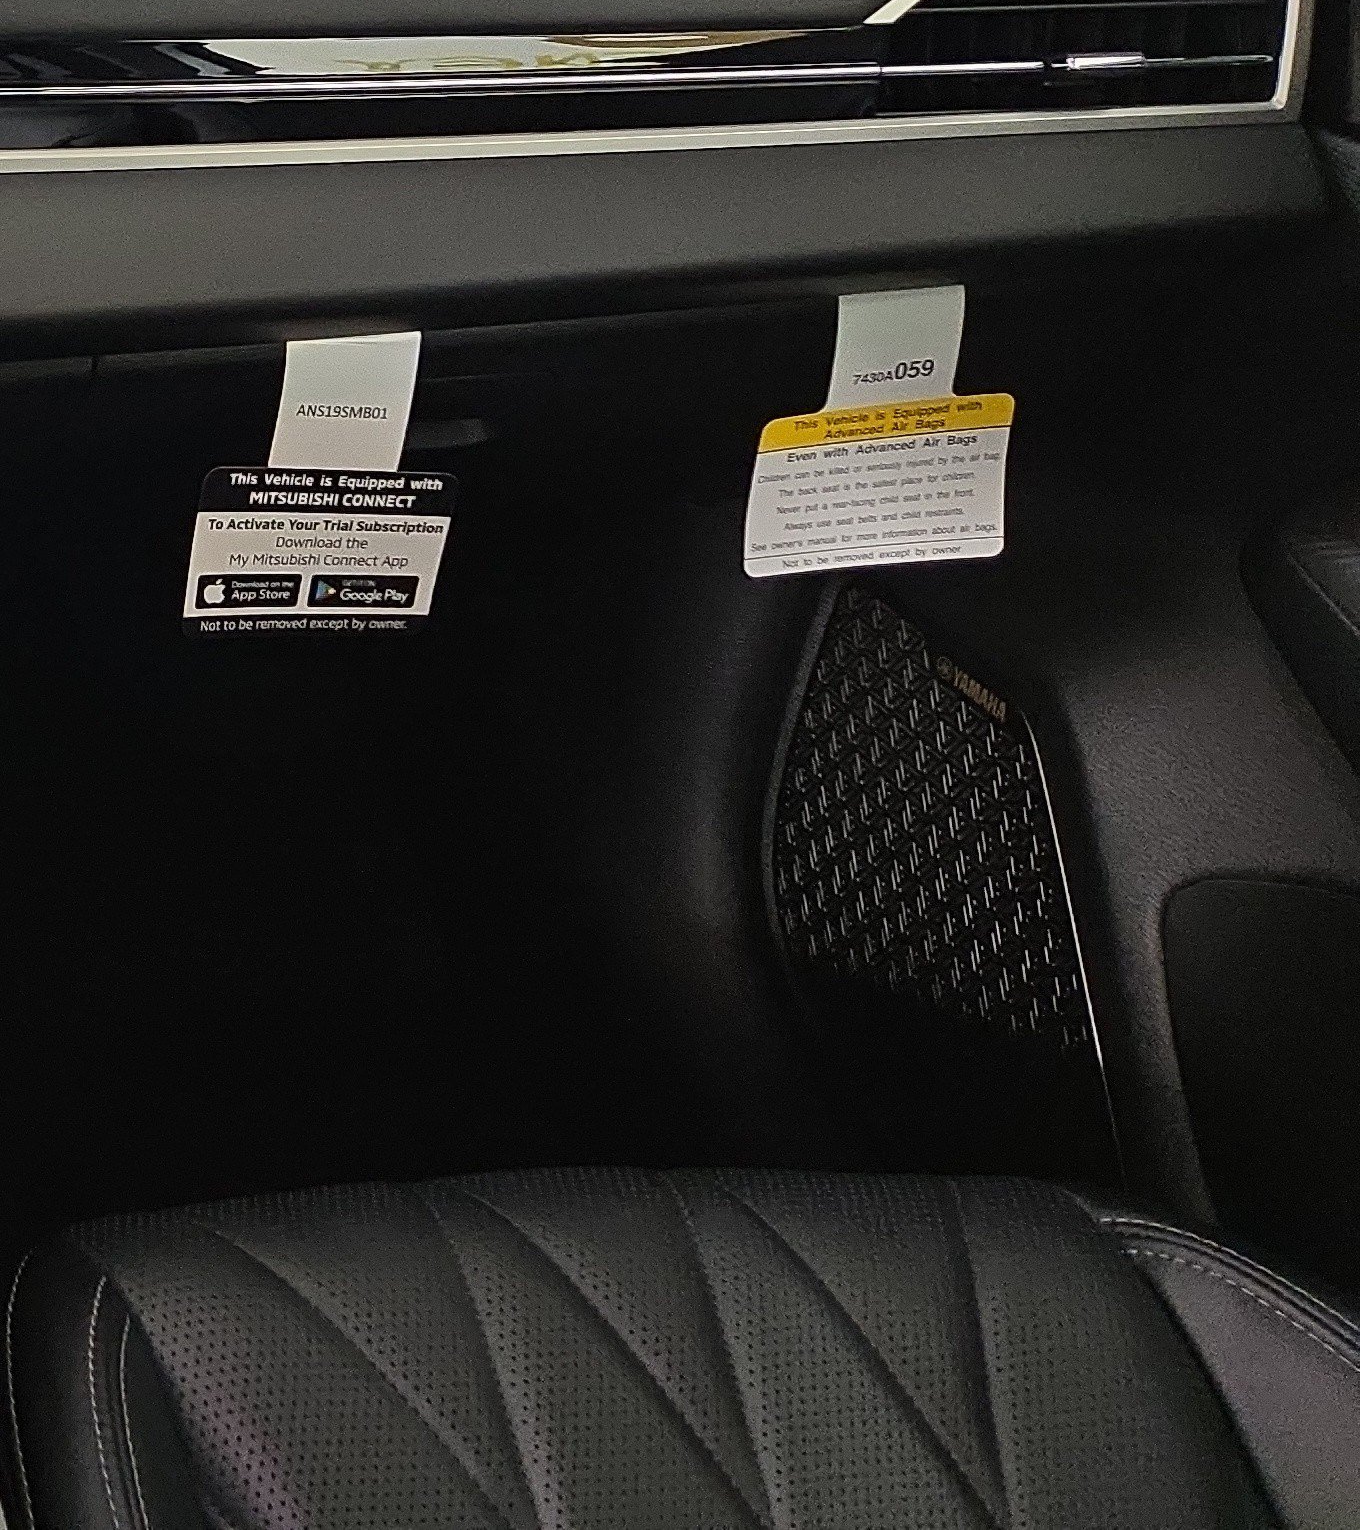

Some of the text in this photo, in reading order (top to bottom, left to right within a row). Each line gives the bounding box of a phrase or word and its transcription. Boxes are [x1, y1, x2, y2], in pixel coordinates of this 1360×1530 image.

[296, 403, 388, 420] ANS19SMB01
[793, 400, 983, 432] This Vehicle is Equipped with
[824, 418, 947, 440] Advanced Air Bags
[787, 433, 978, 463] Even with Advanced Air Bags
[230, 473, 443, 491] This Vehicle is Equipped with
[249, 491, 417, 508] MITSUBISHI CONNECT
[208, 518, 444, 536] To Activate Your Trial Subscription
[275, 536, 369, 549] Download the
[229, 553, 409, 569] My Mitsubishi Connect App
[231, 589, 291, 603] App Store
[340, 588, 410, 604] Google Play
[201, 621, 222, 632] Not
[223, 620, 237, 631] to
[238, 619, 253, 630] be
[255, 618, 307, 630] removed
[309, 619, 349, 632] except
[351, 618, 367, 631] by
